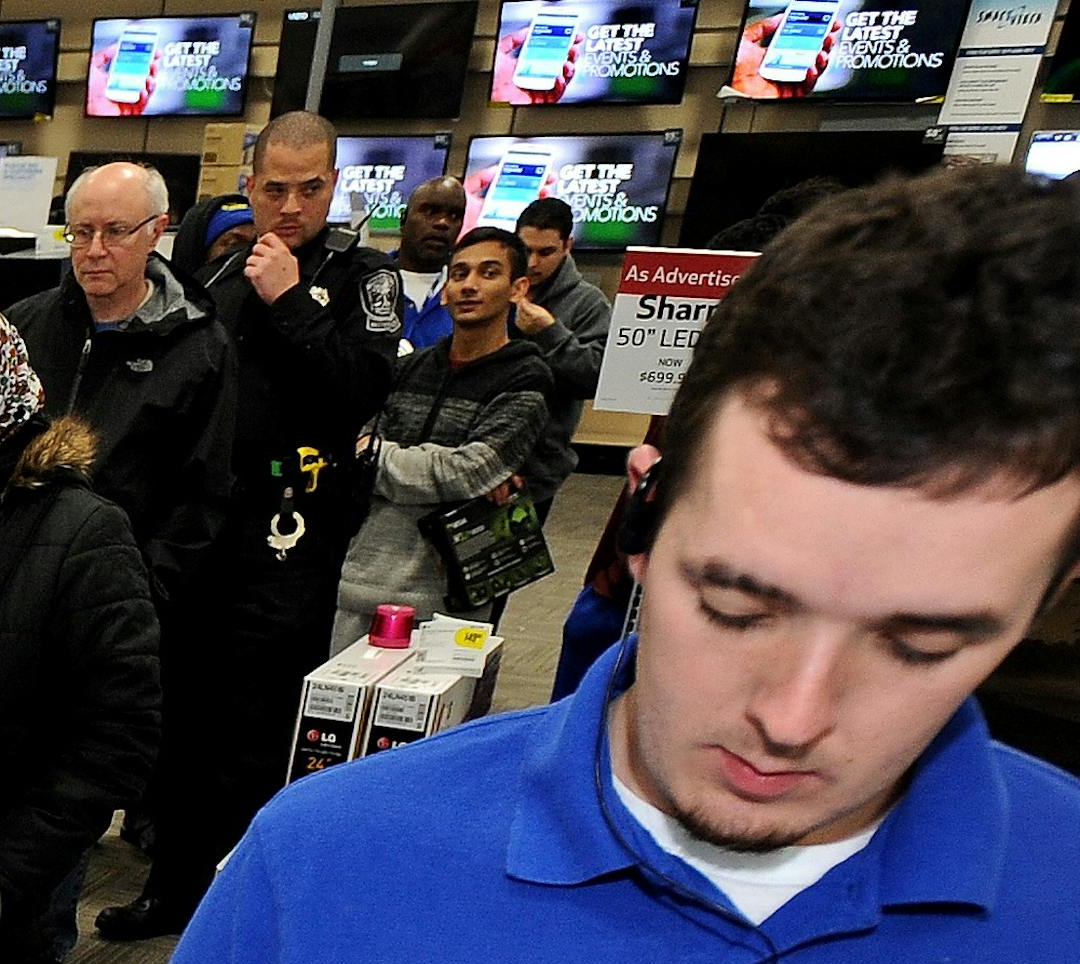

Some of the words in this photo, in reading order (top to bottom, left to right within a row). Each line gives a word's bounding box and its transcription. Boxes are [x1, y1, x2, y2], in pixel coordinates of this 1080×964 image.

[845, 11, 880, 27] GET
[881, 10, 918, 26] THE
[587, 24, 621, 40] GET
[622, 23, 656, 38] THE
[842, 25, 904, 41] LATEST
[3, 46, 27, 60] THE
[164, 41, 192, 55] GET
[193, 41, 220, 55] THE
[585, 38, 645, 52] LATEST
[840, 39, 896, 55] EVENTS
[896, 38, 911, 54] &
[163, 54, 212, 68] LATEST
[584, 51, 637, 64] EVENTS
[638, 49, 652, 63] &
[836, 52, 944, 69] PROMOTIONS
[585, 61, 680, 78] PROMOTIONS
[174, 77, 242, 92] OMOTIONS
[342, 165, 374, 180] GET
[374, 164, 406, 180] THE
[561, 163, 597, 180] GET
[597, 163, 634, 180] THE
[341, 178, 395, 193] LATEST
[560, 178, 621, 195] LATEST
[614, 191, 629, 208] &
[572, 205, 659, 223] OMOTIONS
[624, 265, 650, 282] As
[616, 327, 656, 347] 50"
[660, 328, 704, 349] LED
[658, 358, 683, 368] NOW
[320, 732, 337, 743] LG
